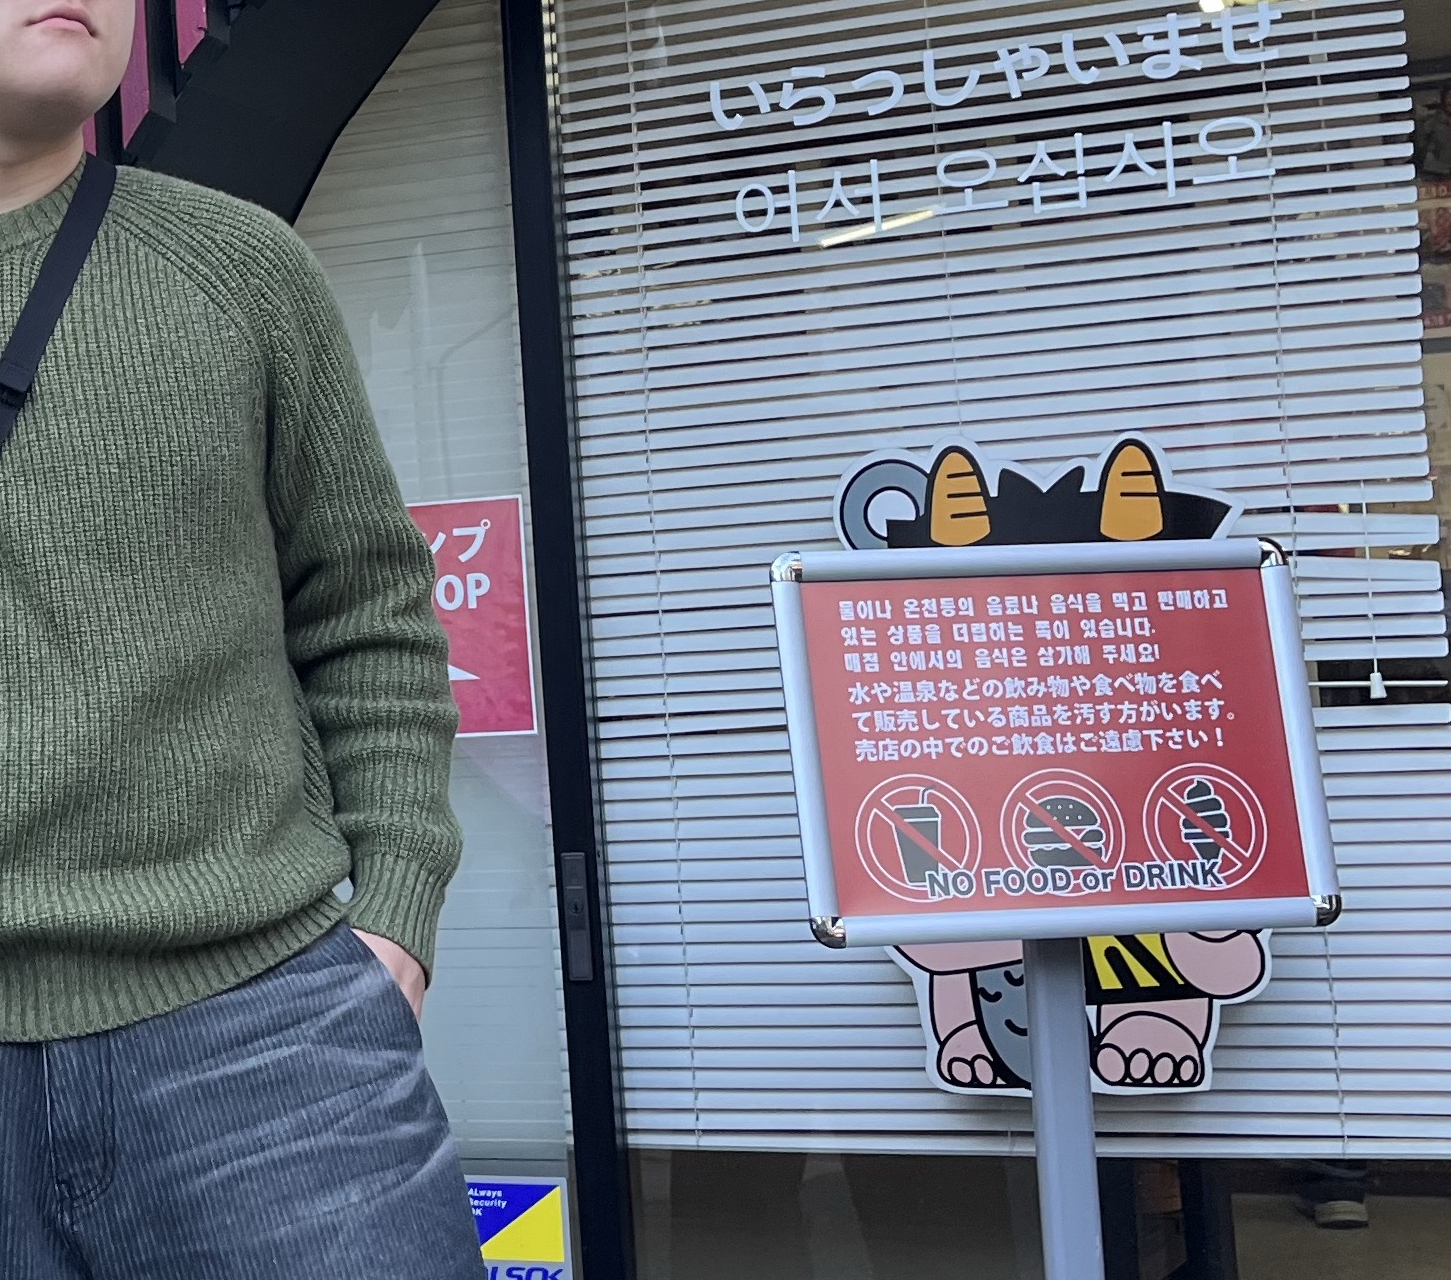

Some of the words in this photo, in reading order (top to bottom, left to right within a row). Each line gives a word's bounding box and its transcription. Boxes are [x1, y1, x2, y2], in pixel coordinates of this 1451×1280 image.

[709, 1, 1282, 130] いらっしゃいませ
[735, 158, 882, 242] 어서
[934, 116, 1276, 215] 오십시오
[839, 599, 892, 620] 물이나
[986, 595, 1038, 616] 음료나
[1050, 593, 1102, 614] 음식을
[1112, 591, 1148, 611] 먹고
[1157, 589, 1228, 610] 판매하고
[840, 627, 877, 646] 있는
[887, 624, 941, 645] 상품을
[1080, 617, 1156, 639] 있습니다.
[843, 652, 879, 672] 매점
[890, 650, 963, 671] 안에서의
[974, 647, 1027, 668] 음식은
[1037, 645, 1091, 666] 삼가해
[1102, 643, 1159, 664] 주세요!
[848, 670, 1223, 705] 水や温泉などの飲み物や食べ物を食べ
[852, 698, 1235, 732] て販売している商品を汚す方がいます。
[926, 870, 974, 898] NO
[982, 867, 1074, 897] FOOD
[1080, 868, 1115, 893] or
[1123, 860, 1225, 891] DRINK
